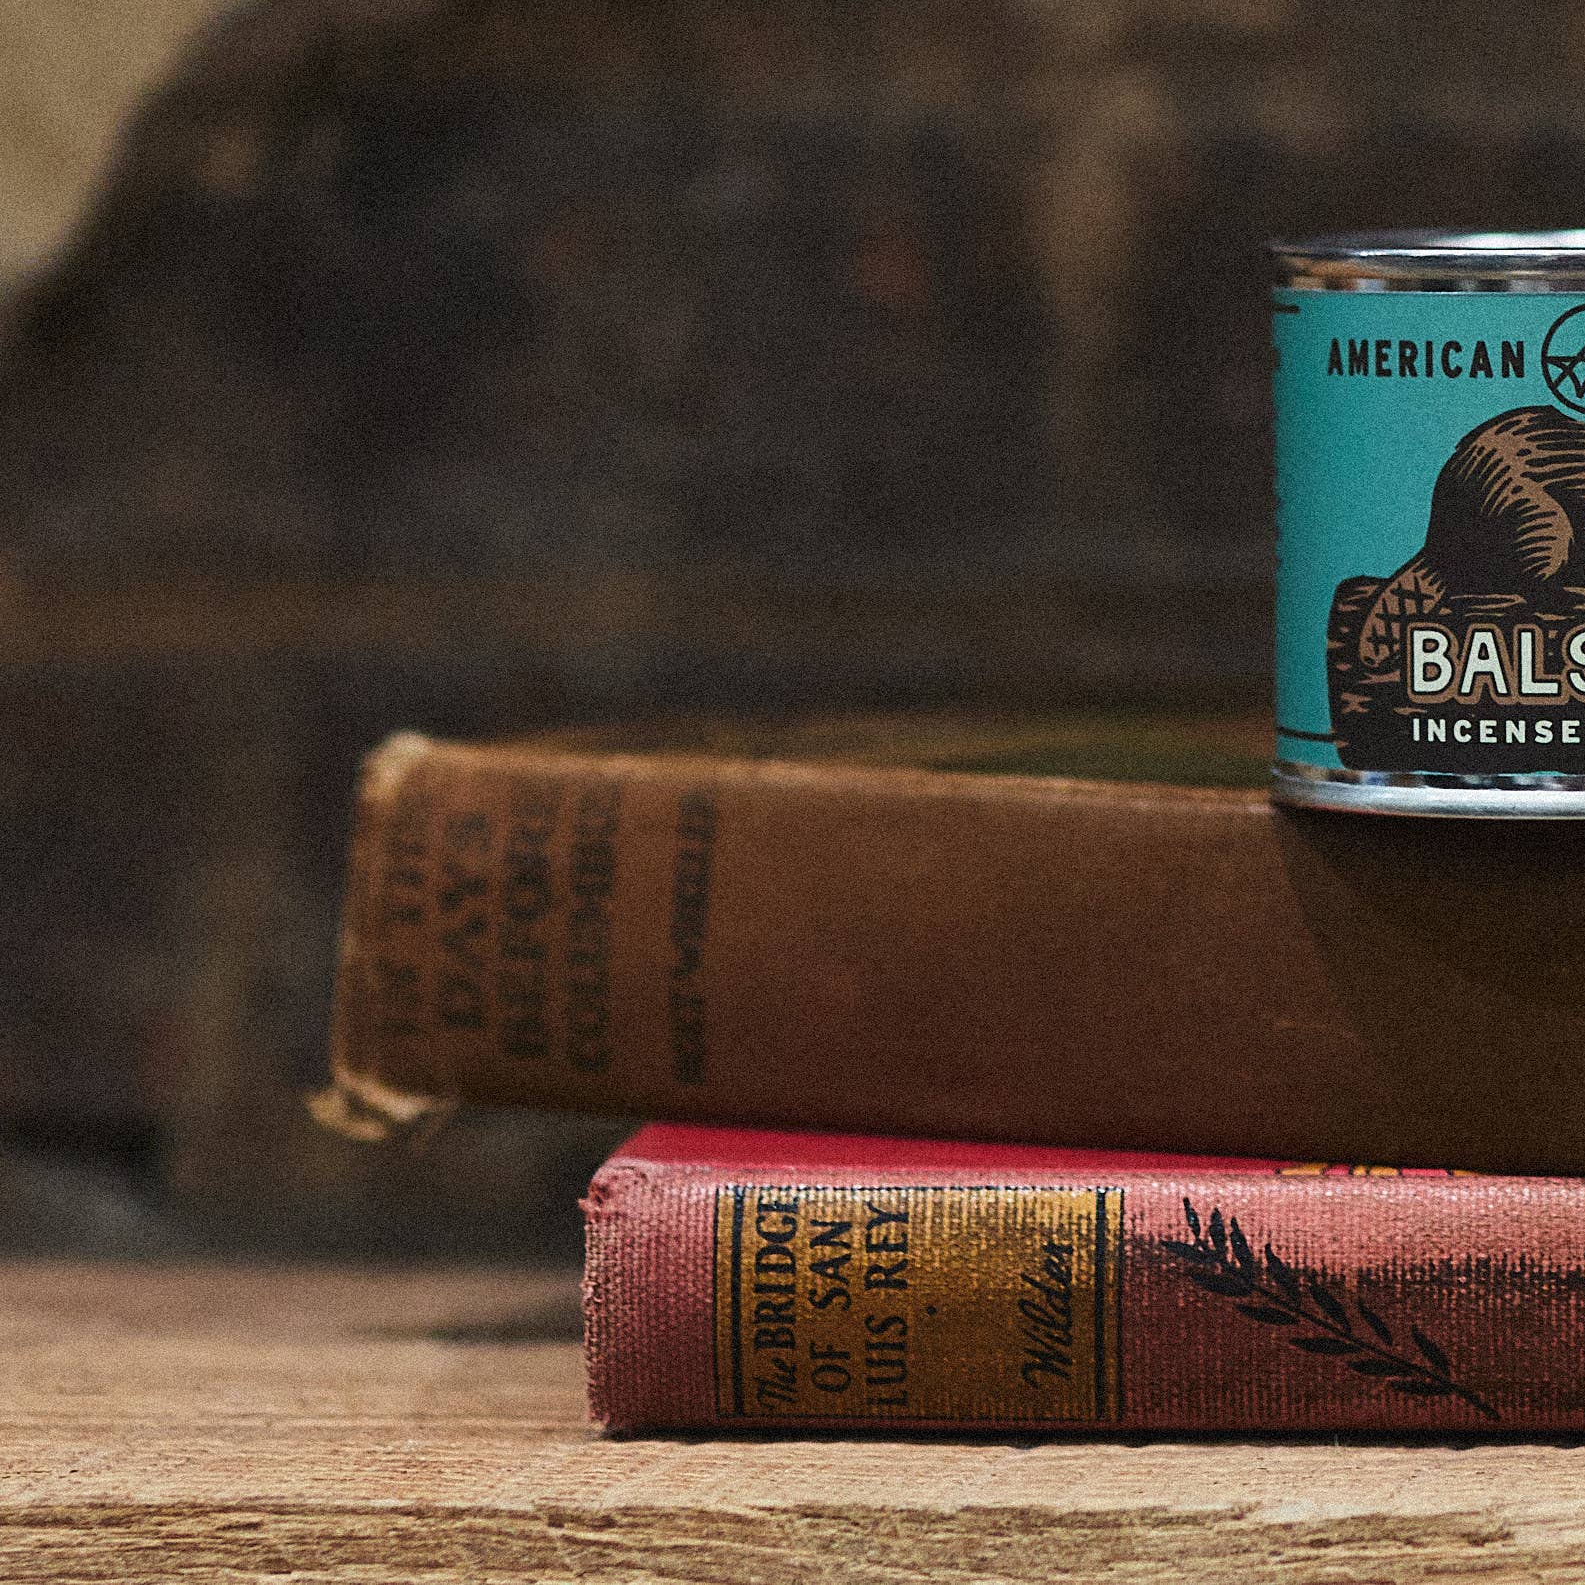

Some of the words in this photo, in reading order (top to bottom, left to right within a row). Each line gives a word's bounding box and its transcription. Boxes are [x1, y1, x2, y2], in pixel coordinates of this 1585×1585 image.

[1327, 336, 1525, 379] AMERICAN
[1412, 717, 1581, 745] INCENSE
[754, 1190, 800, 1351] BRIDGE
[808, 1218, 852, 1312] SAN
[865, 1199, 910, 1292] REY
[865, 1314, 909, 1407] LUIS
[1017, 1239, 1075, 1391] Wilder
[755, 1356, 798, 1410] The
[809, 1342, 852, 1394] OF
